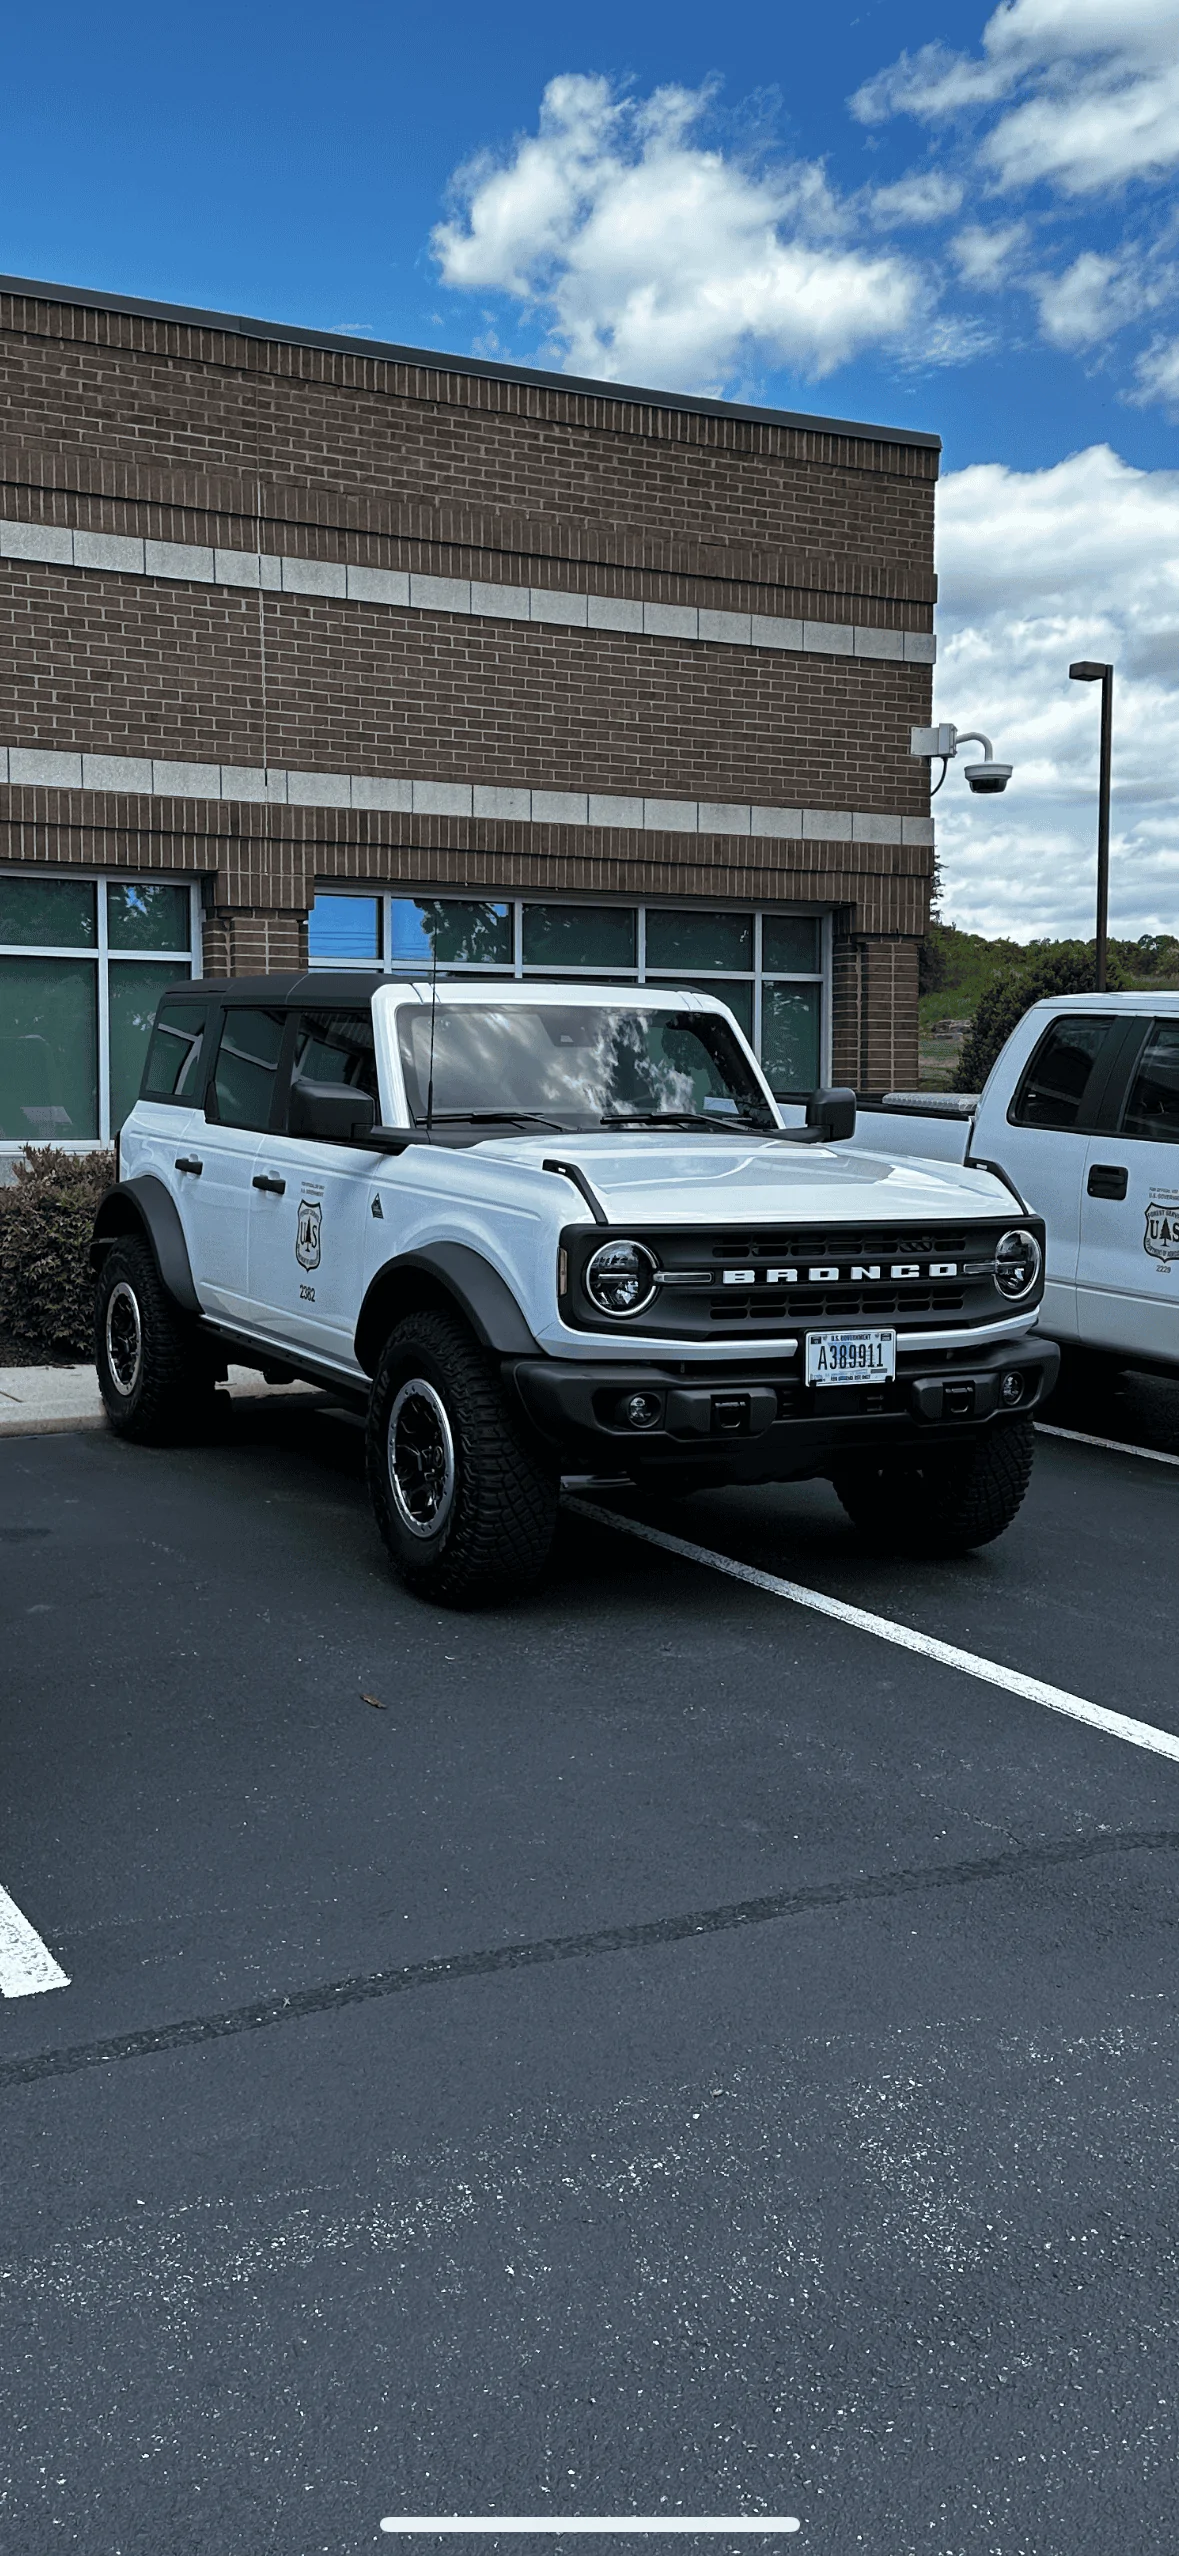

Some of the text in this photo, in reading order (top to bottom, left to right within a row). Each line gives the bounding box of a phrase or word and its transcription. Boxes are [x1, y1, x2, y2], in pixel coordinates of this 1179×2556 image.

[723, 1263, 957, 1284] BRONCO
[300, 1285, 316, 1302] 2382
[818, 1343, 883, 1370] A389911
